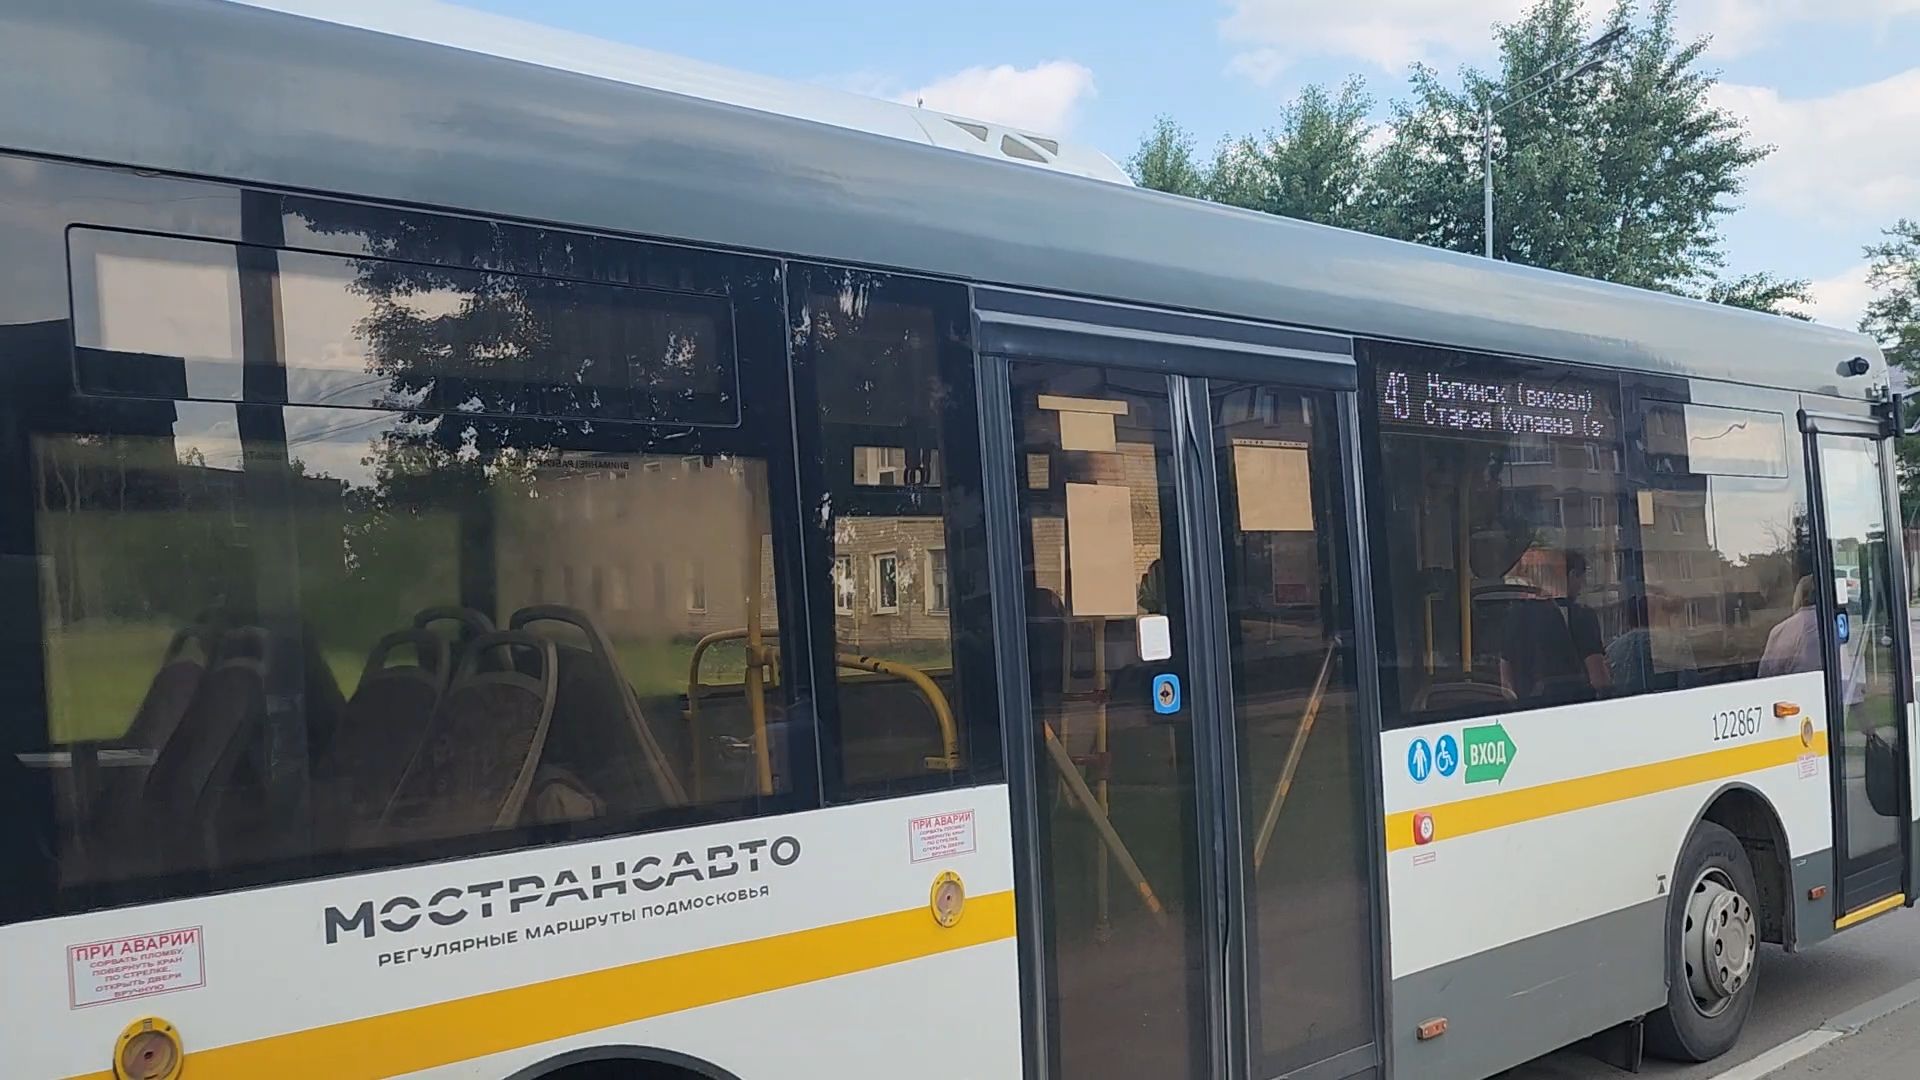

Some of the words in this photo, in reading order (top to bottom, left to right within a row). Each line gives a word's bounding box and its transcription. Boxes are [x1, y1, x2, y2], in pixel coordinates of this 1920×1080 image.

[1427, 372, 1507, 404] Ногинск
[1517, 382, 1592, 412] (вокзал)
[1423, 400, 1493, 430] Старая
[1501, 406, 1573, 434] Купавна
[1712, 706, 1763, 741] 122867
[1470, 740, 1507, 766] ВХОД
[914, 819, 932, 830] ПРИ
[935, 813, 971, 827] АВАРИИ
[324, 835, 801, 944] МОСТРАНСАВТО
[378, 930, 518, 967] РЕГУЛЯРНЫЕ
[525, 908, 636, 940] МАРШРУТЫ
[641, 885, 770, 919] ПОДМОСКОВЬЯ
[76, 943, 114, 961] ПРИ
[120, 931, 196, 955] АВАРИИ
[89, 955, 138, 969] СОРВАТЬ
[92, 962, 155, 977] ПОВЕРНУТЬ
[157, 957, 183, 966] КРАН
[95, 979, 146, 992] ОТКРЫТЬ
[147, 973, 182, 985] ДВЕРИ
[104, 974, 121, 983] ПО
